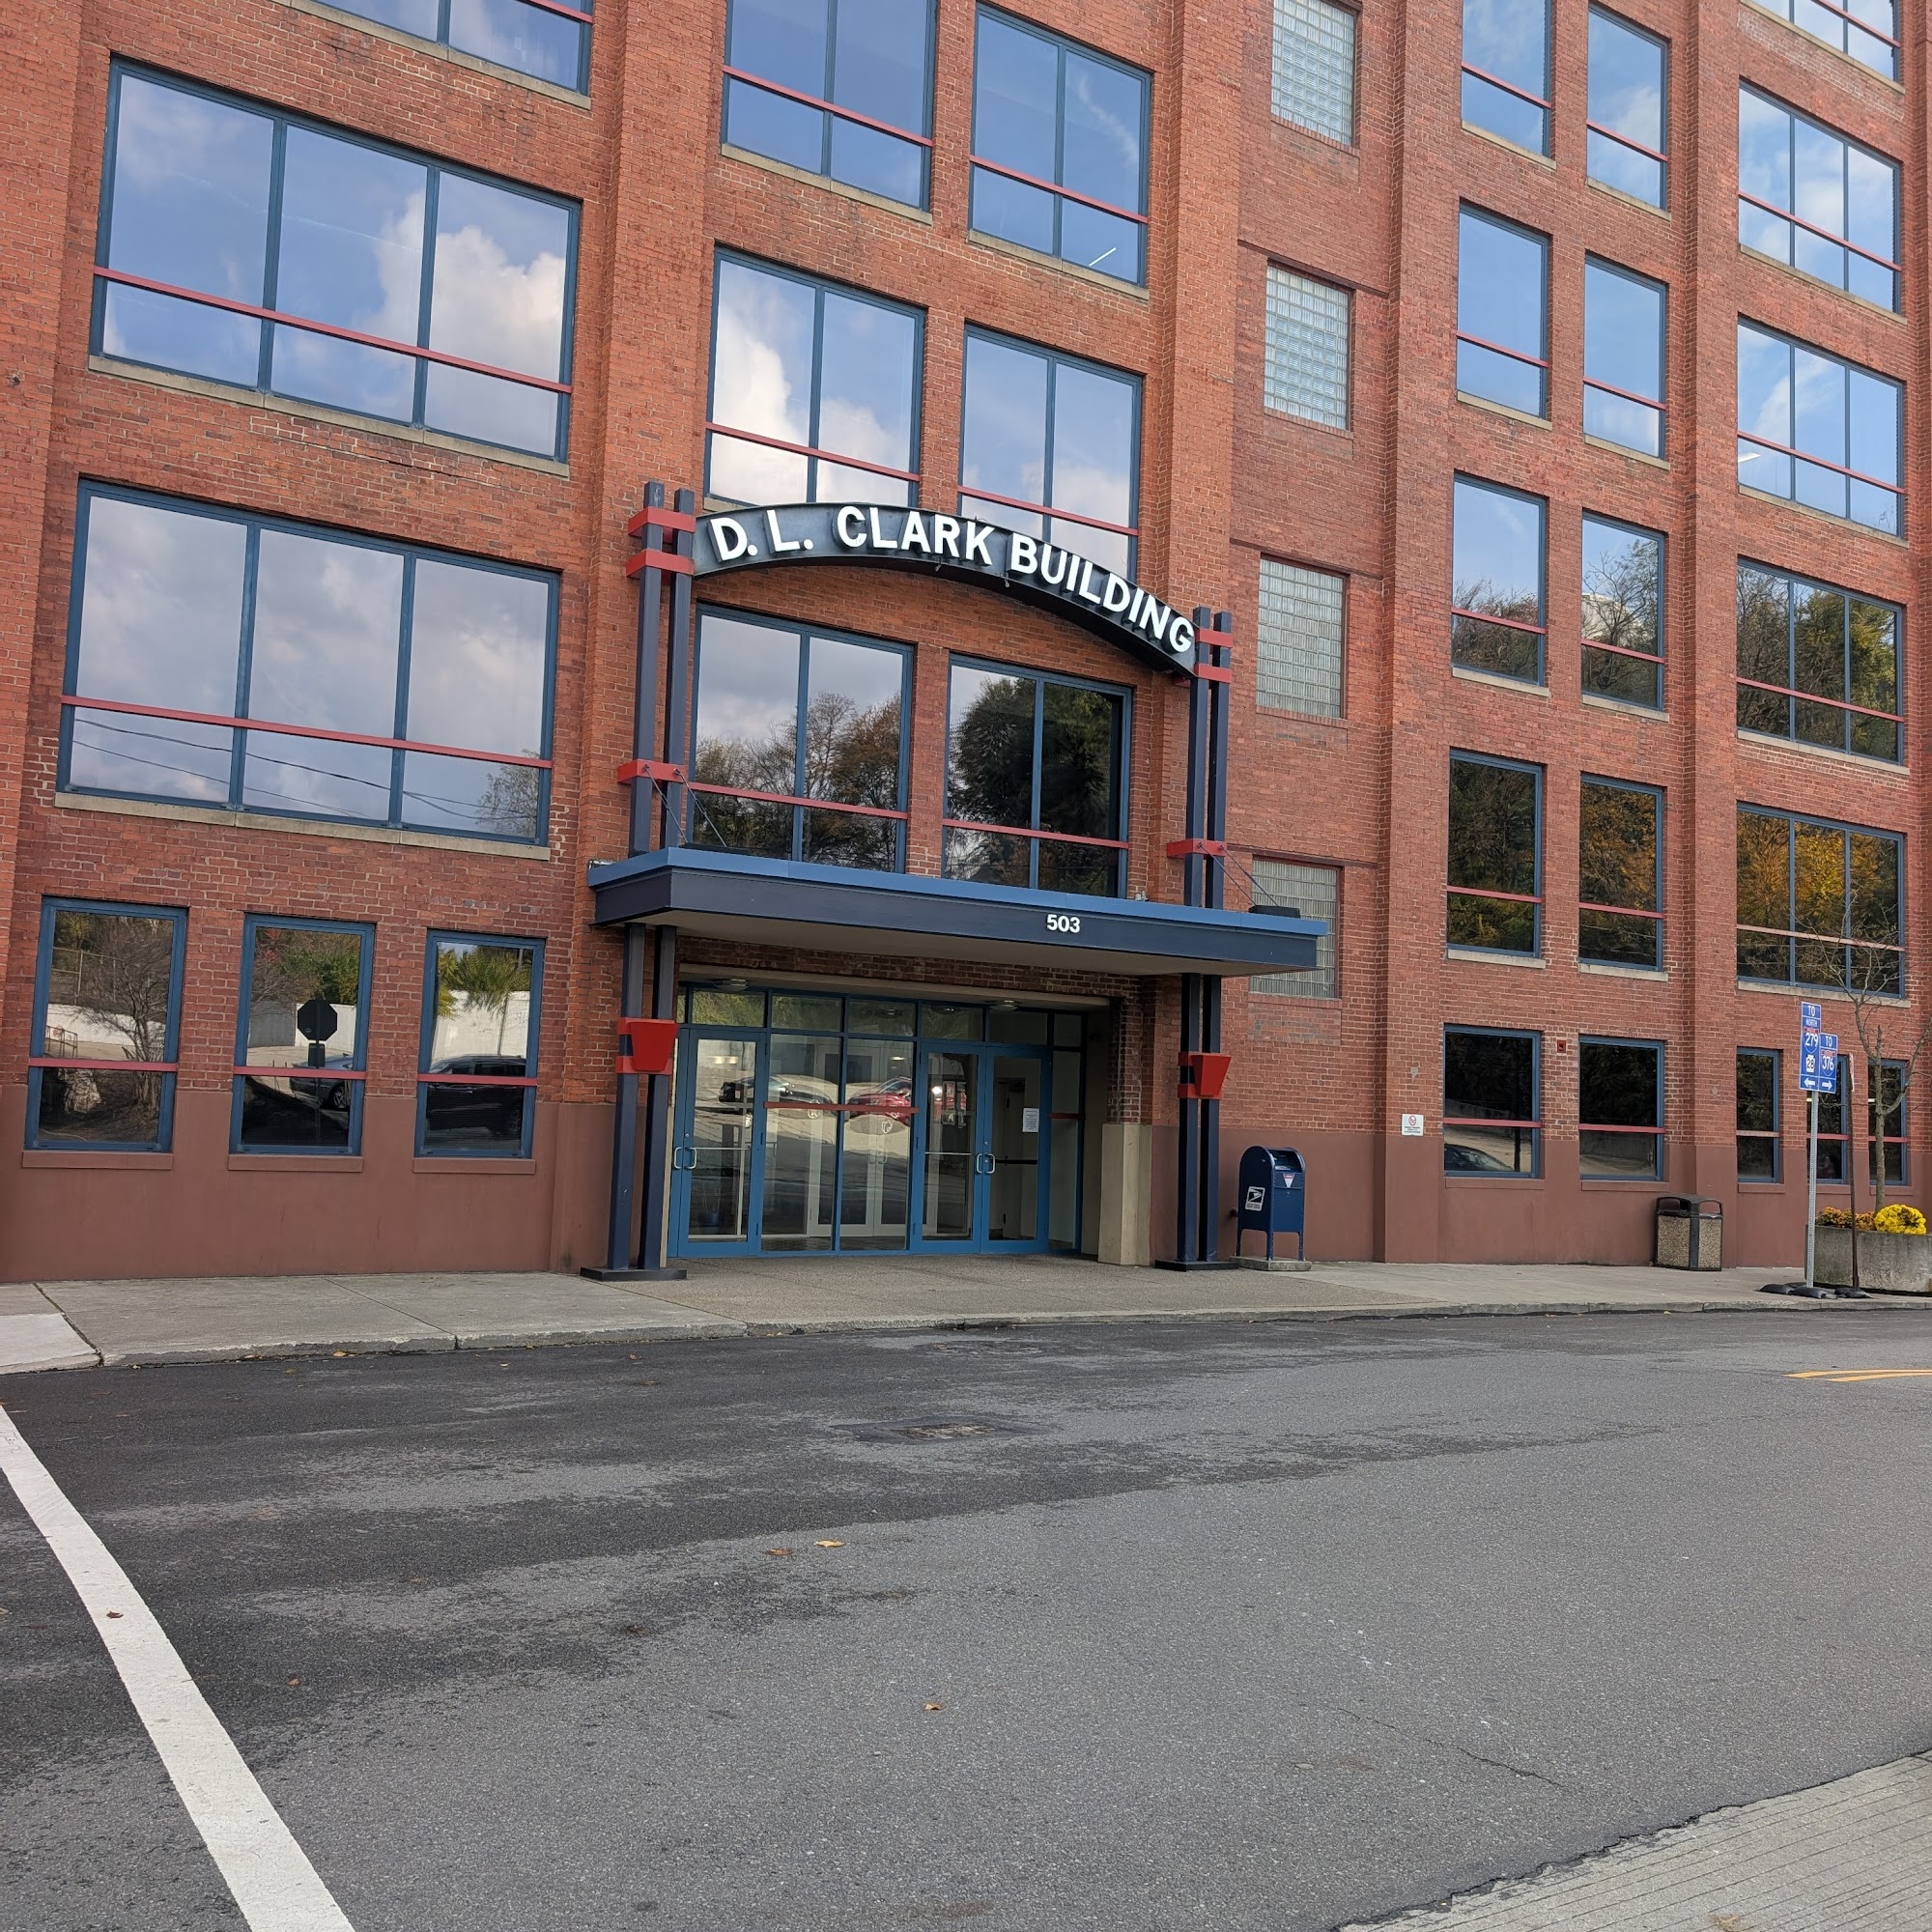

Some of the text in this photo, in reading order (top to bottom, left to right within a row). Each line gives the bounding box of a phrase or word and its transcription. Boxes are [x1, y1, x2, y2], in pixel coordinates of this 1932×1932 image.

[710, 506, 1195, 653] D. L. CLARK BUILDING
[1046, 914, 1080, 933] 503
[1807, 1006, 1816, 1017] TO
[1805, 1033, 1818, 1047] 279
[1825, 1036, 1833, 1047] TO
[1806, 1058, 1814, 1069] 28
[1822, 1056, 1834, 1070] 376
